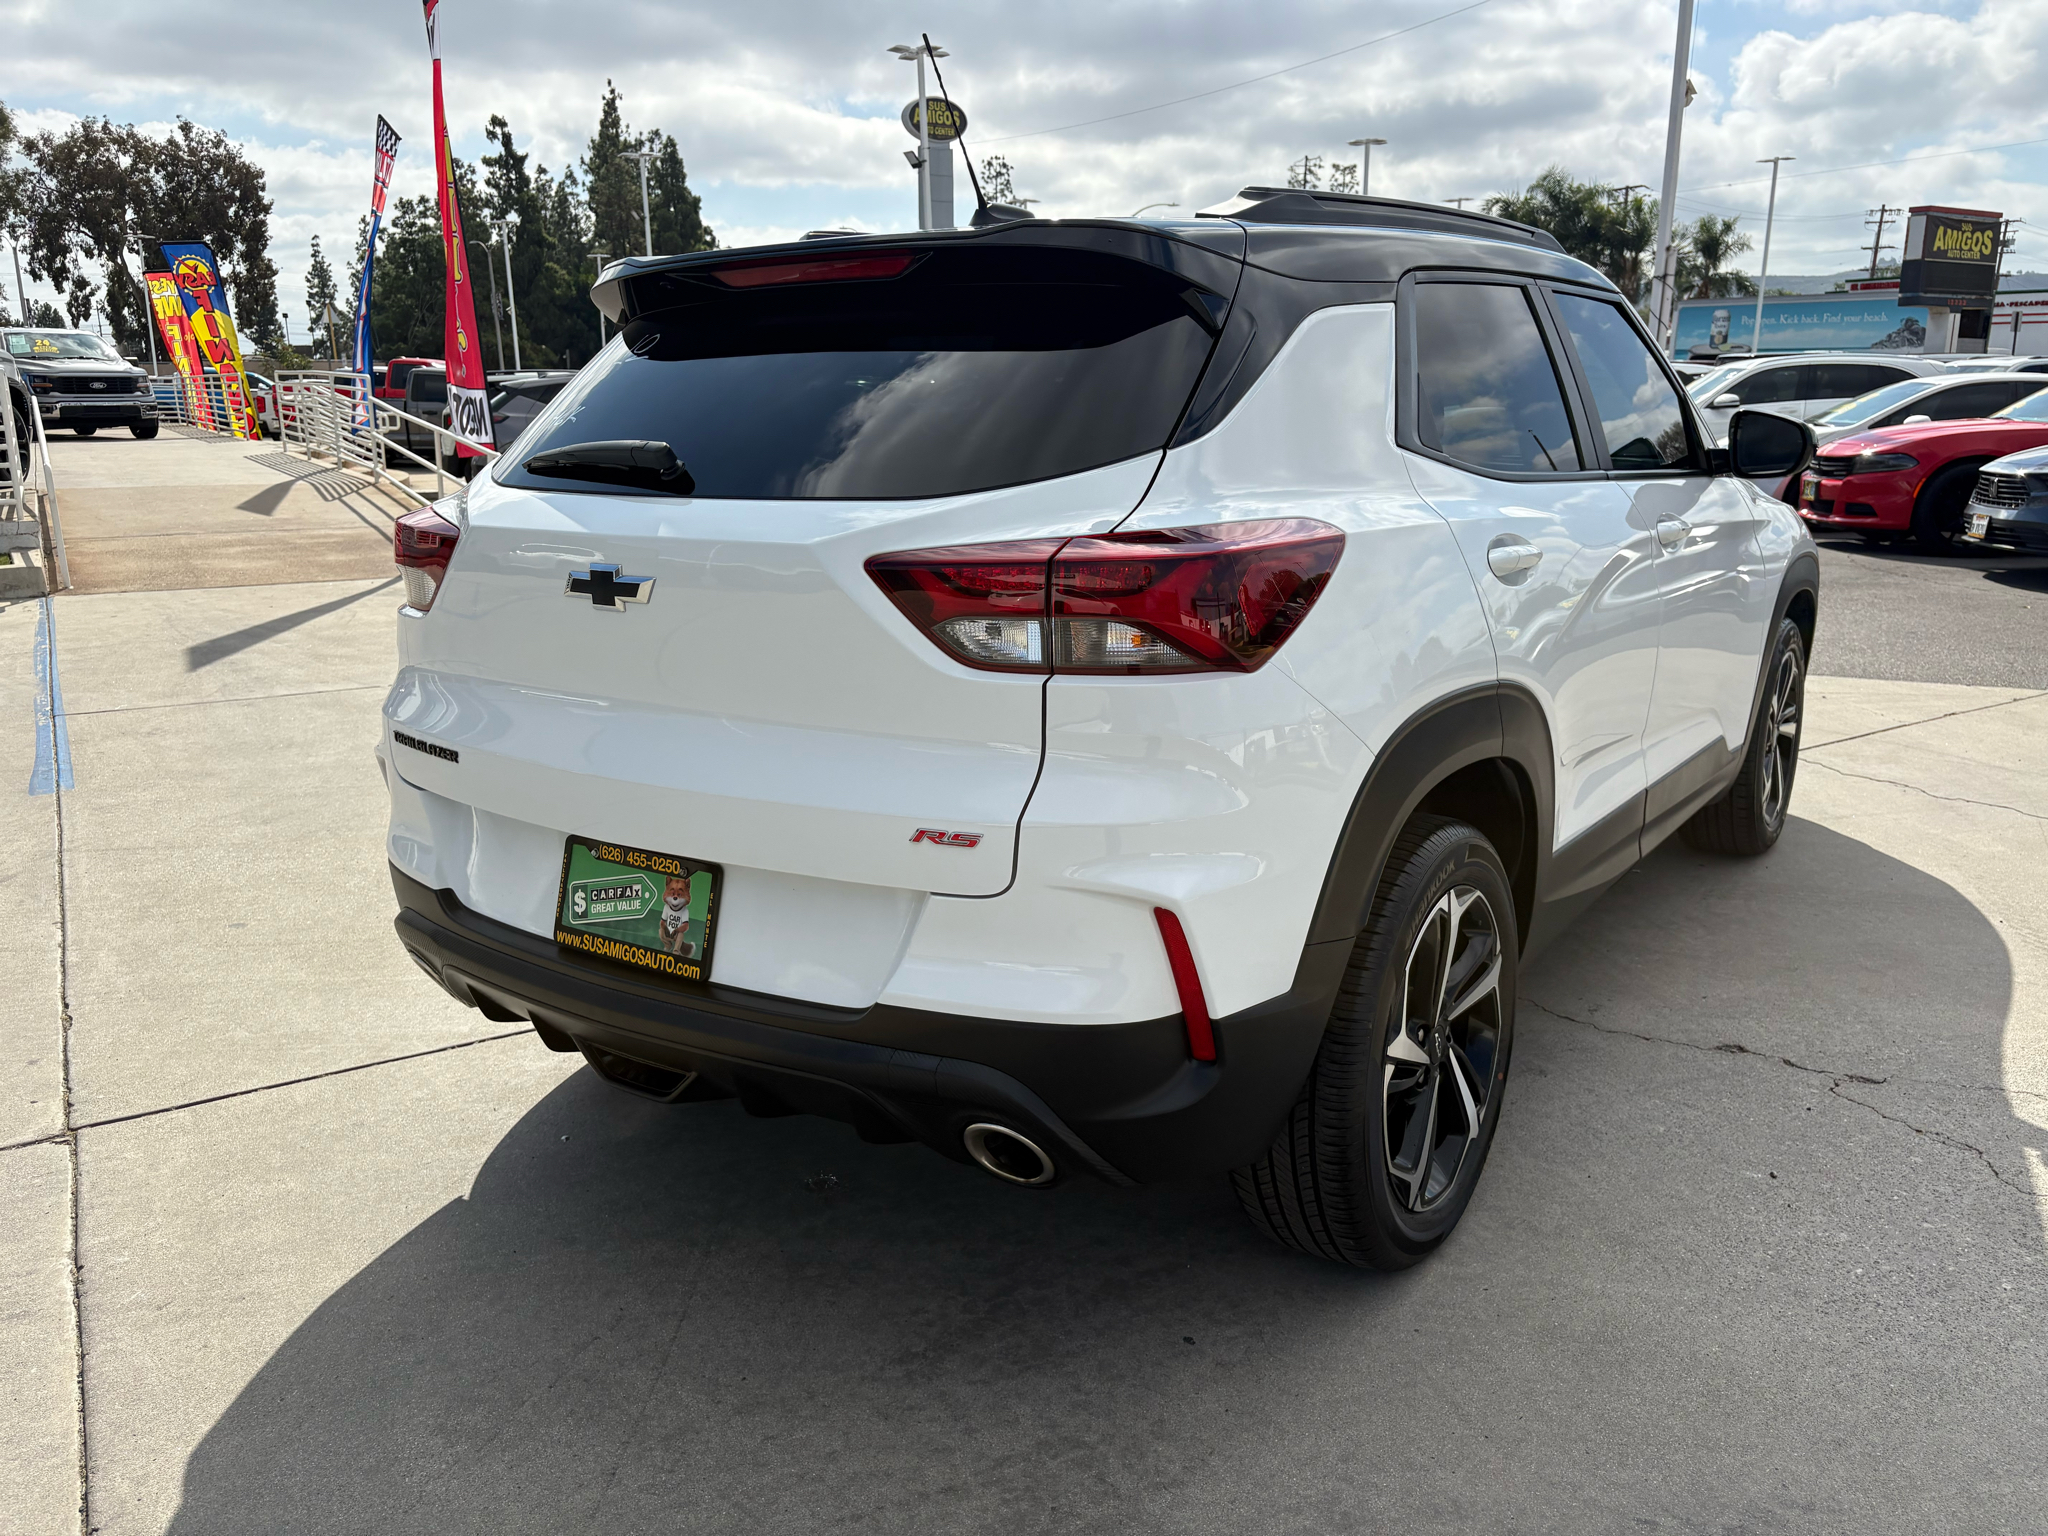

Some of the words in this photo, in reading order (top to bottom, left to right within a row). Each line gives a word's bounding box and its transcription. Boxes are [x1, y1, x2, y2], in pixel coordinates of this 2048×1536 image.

[928, 101, 946, 111] SUS
[935, 127, 955, 136] CENTER
[1961, 222, 1973, 231] SUS
[1933, 226, 1993, 255] AMIGOS
[1947, 249, 1960, 258] AUTO
[1961, 251, 1980, 259] CENTER
[1780, 314, 1799, 324] Kick
[1801, 314, 1820, 324] back.
[1822, 313, 1842, 323] Find
[1843, 315, 1862, 326] your
[1864, 312, 1889, 322] beach.
[909, 828, 984, 848] RS
[599, 844, 624, 863] (626)
[627, 851, 680, 875] 455-0250
[590, 884, 642, 902] CARFAX
[591, 901, 615, 914] GREAT
[616, 900, 642, 911] VALUE
[668, 920, 680, 930] FOX
[669, 914, 681, 923] CAR
[556, 930, 701, 980] www.SUSAMIGOSAUTO.com
